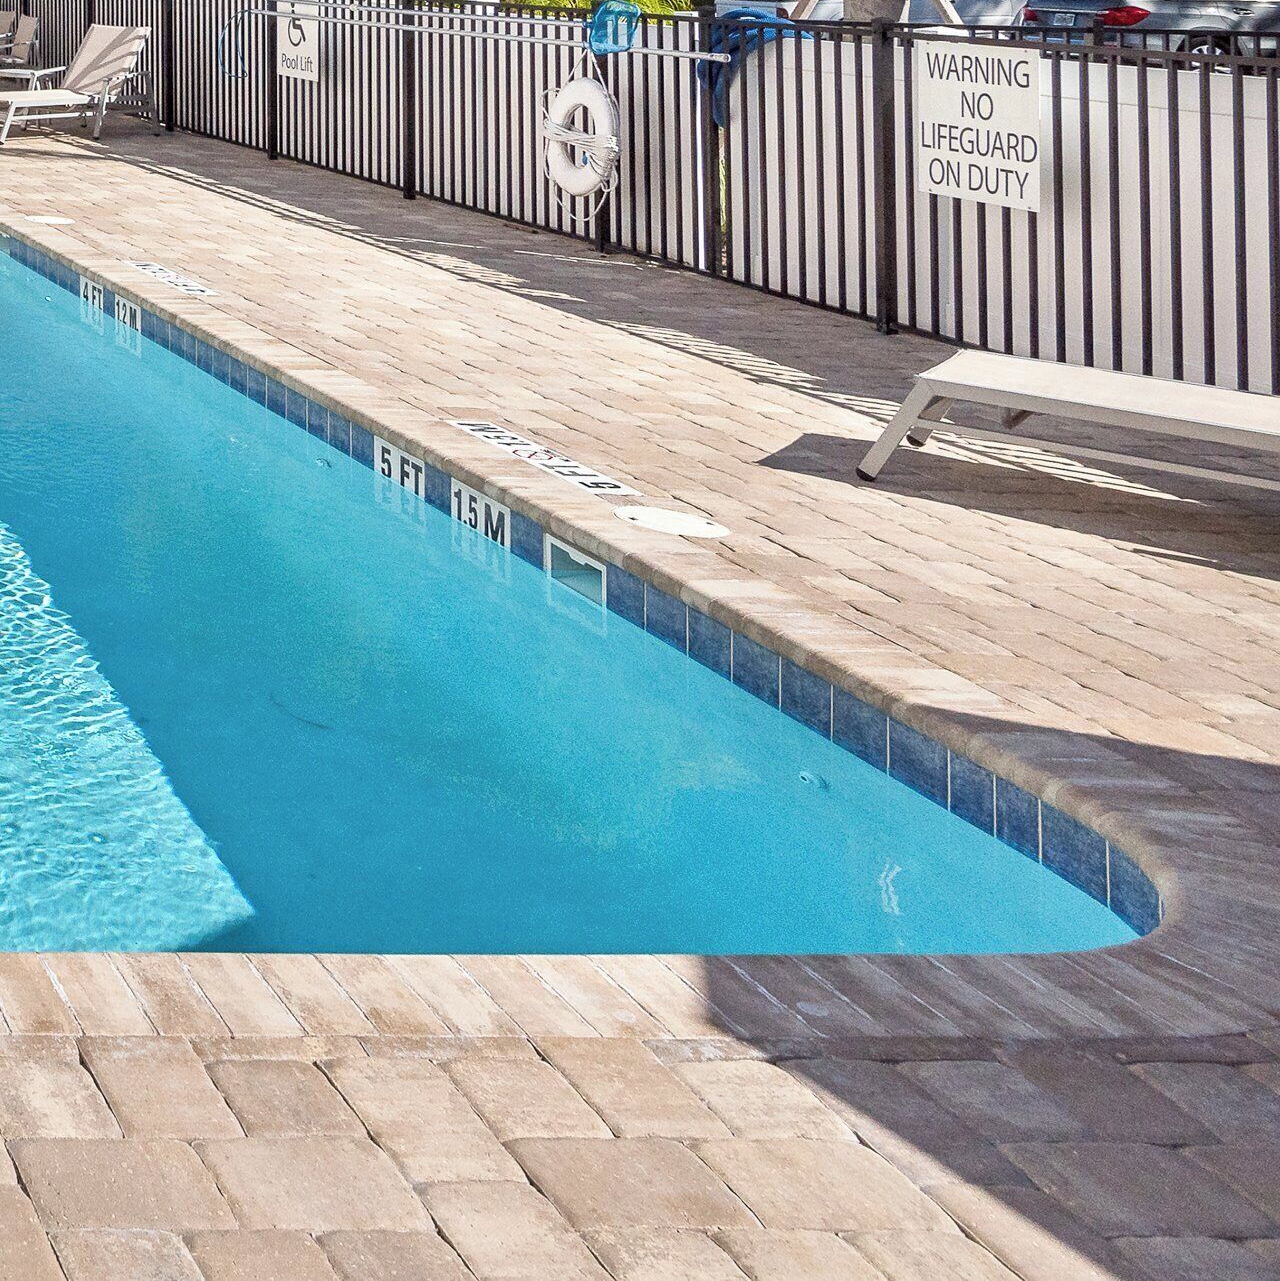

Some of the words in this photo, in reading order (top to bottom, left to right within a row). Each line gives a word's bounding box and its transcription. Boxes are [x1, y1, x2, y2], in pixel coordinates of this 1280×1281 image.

[281, 52, 299, 70] Pool
[300, 56, 314, 73] Lift
[926, 51, 1030, 89] WARNING
[960, 90, 994, 121] NO
[921, 121, 1038, 163] LIFEGUARD
[929, 157, 961, 189] ON
[968, 163, 1029, 200] DUTY
[83, 281, 89, 302] 4
[91, 282, 102, 310] FT
[380, 448, 391, 479] 5
[400, 455, 423, 496] FT
[453, 488, 478, 530] 1.5
[485, 503, 505, 547] M
